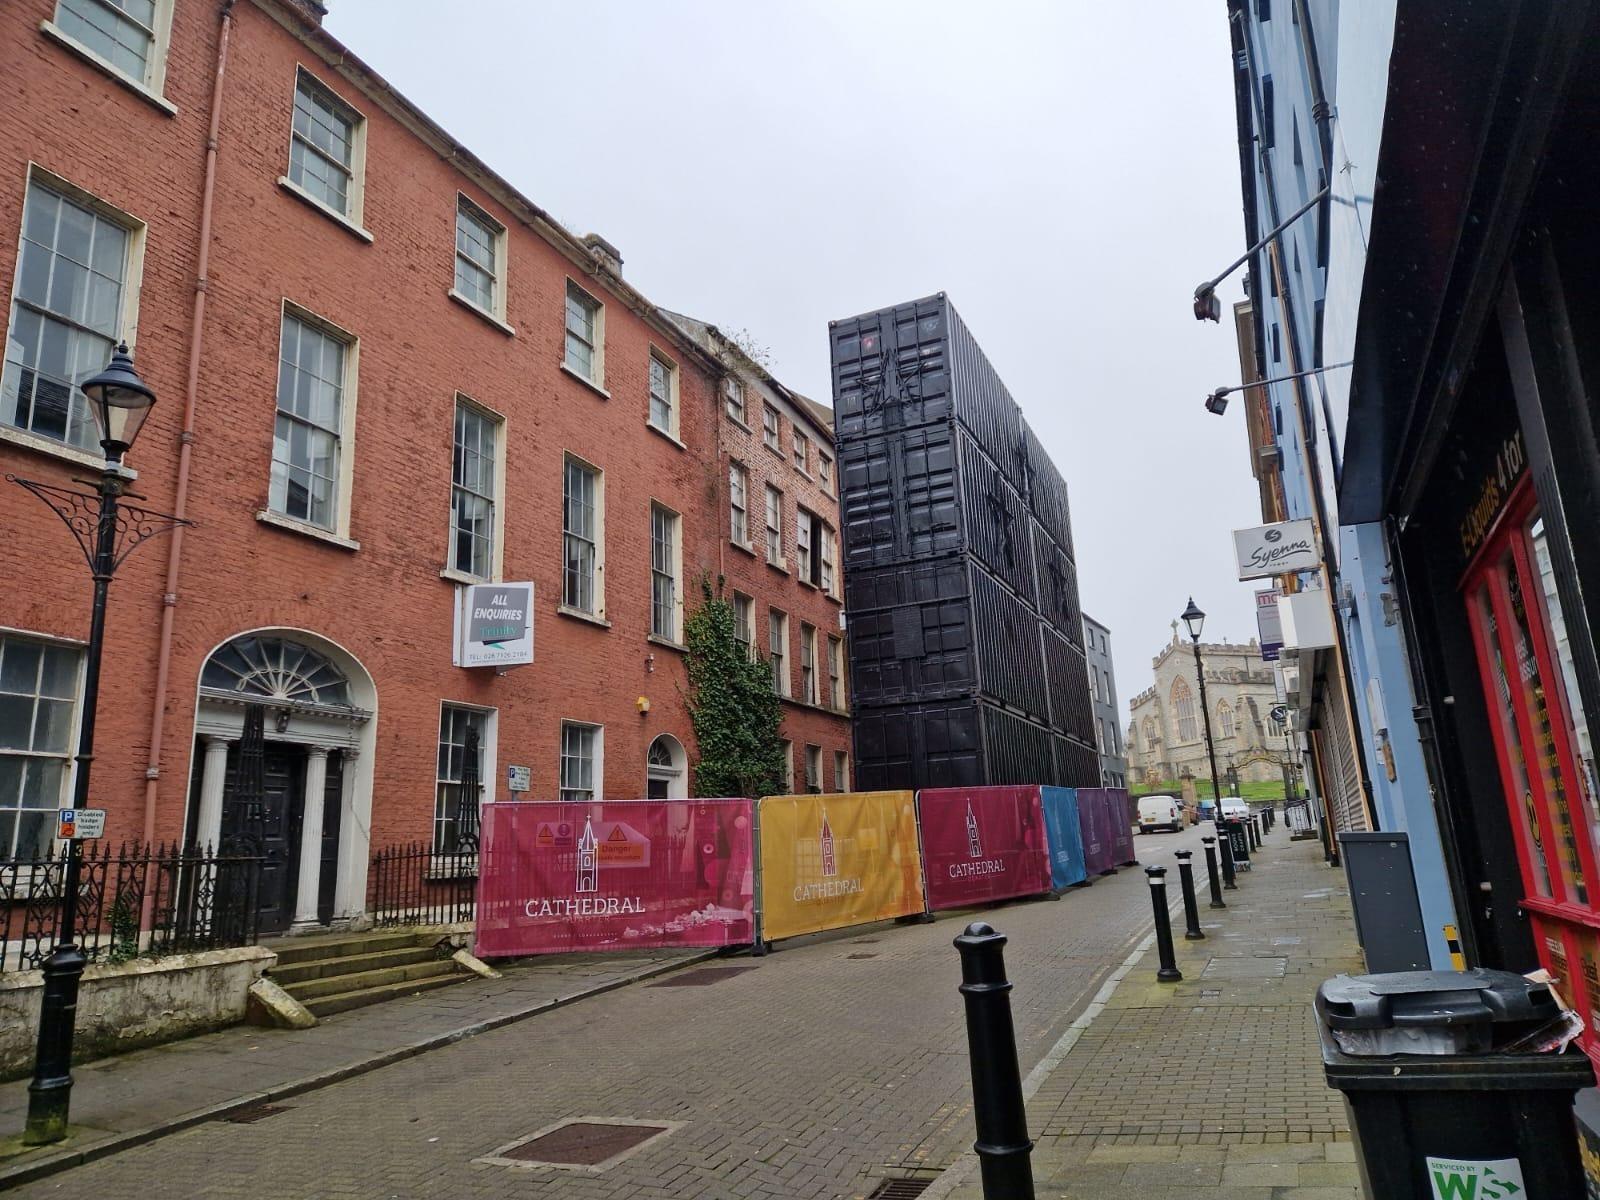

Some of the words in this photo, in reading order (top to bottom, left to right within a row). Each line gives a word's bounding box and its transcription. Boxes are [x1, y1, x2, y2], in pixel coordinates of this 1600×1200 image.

[1504, 430, 1523, 481] for
[1242, 540, 1311, 569] Syenna
[491, 594, 508, 606] ALL
[473, 607, 523, 621] ENQUIRIES
[75, 845, 83, 857] 3
[601, 844, 632, 854] Danger
[949, 859, 1006, 878] CATHEDRAL
[793, 878, 865, 902] CATHEDRAL
[525, 896, 646, 917] CATHEDRAL
[1431, 1162, 1465, 1171] SERVICED
